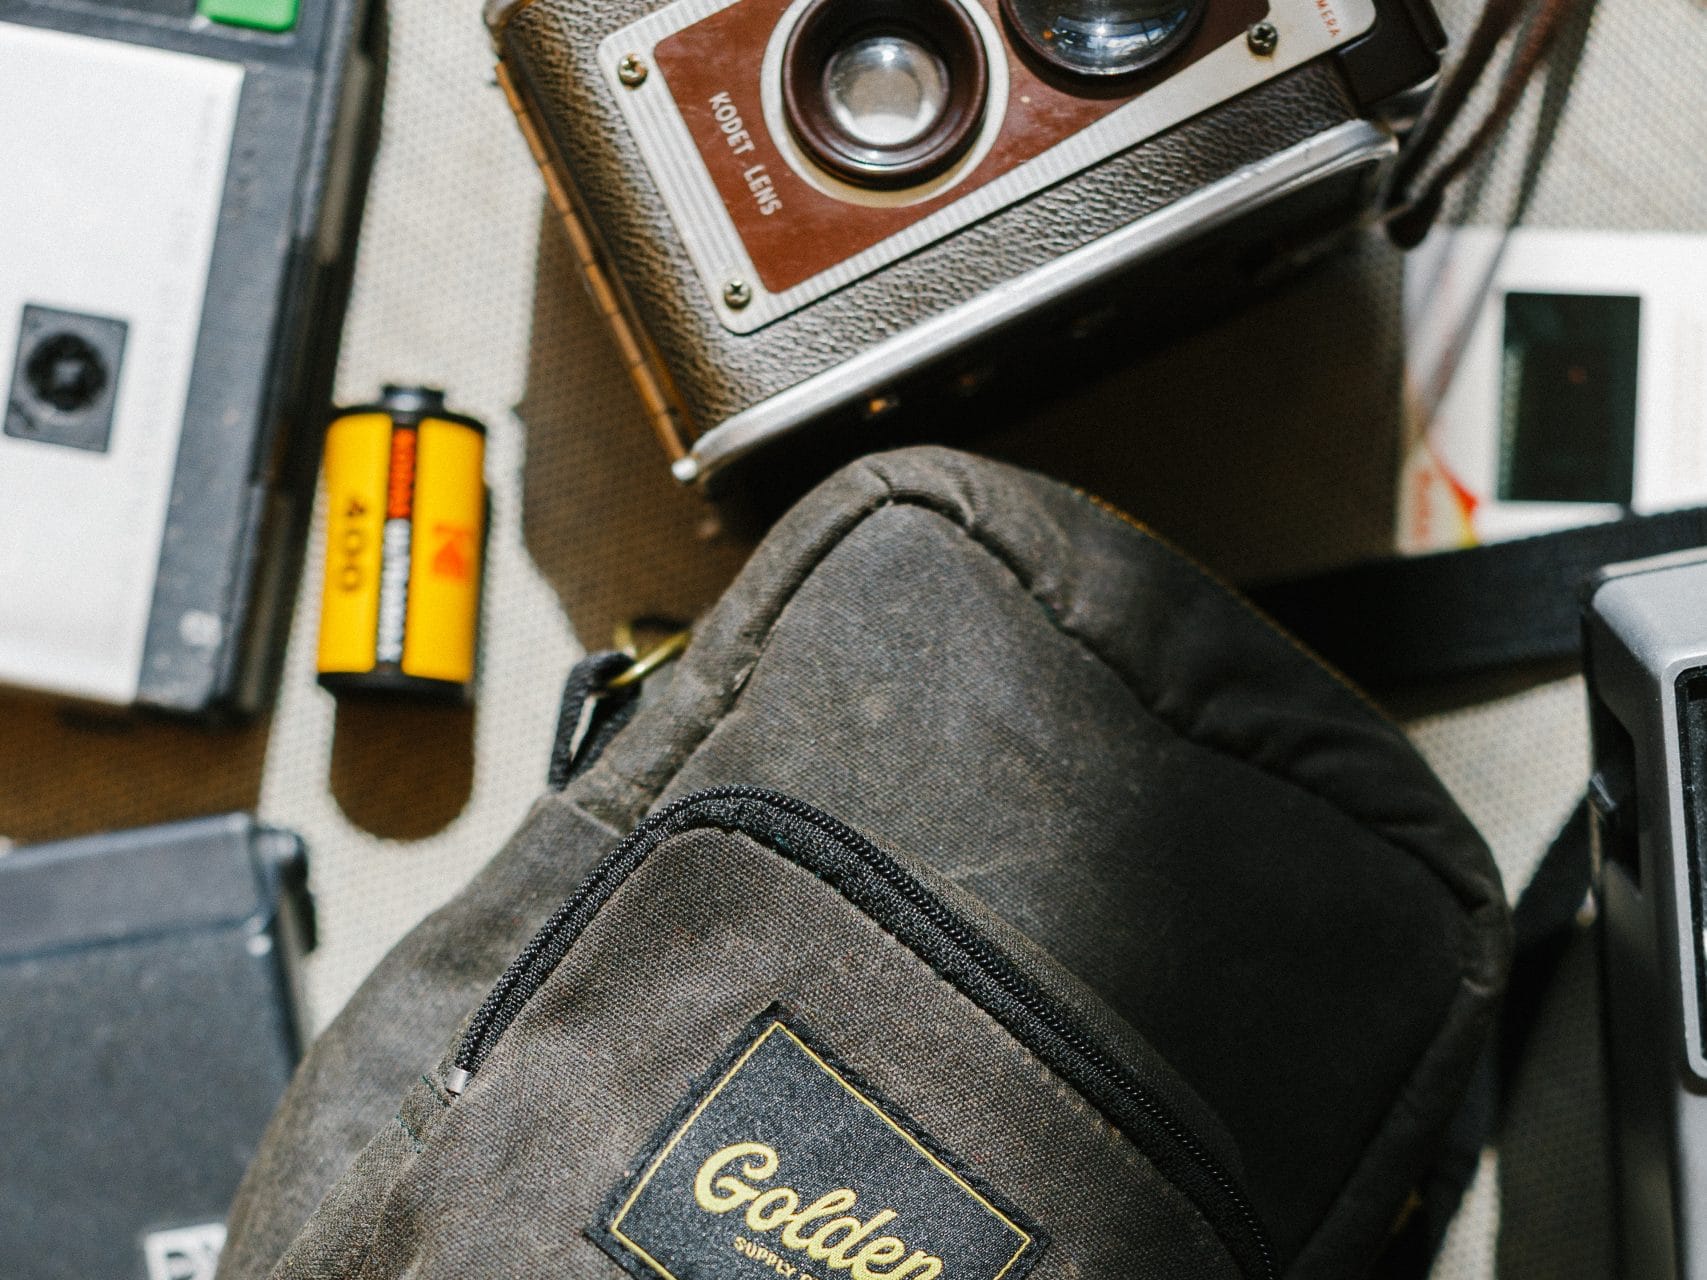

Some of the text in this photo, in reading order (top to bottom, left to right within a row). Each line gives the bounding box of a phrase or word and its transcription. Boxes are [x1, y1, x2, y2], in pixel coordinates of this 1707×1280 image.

[709, 91, 783, 216] KODET LENS
[340, 497, 368, 592] 400
[733, 1235, 798, 1279] SUPPLY
